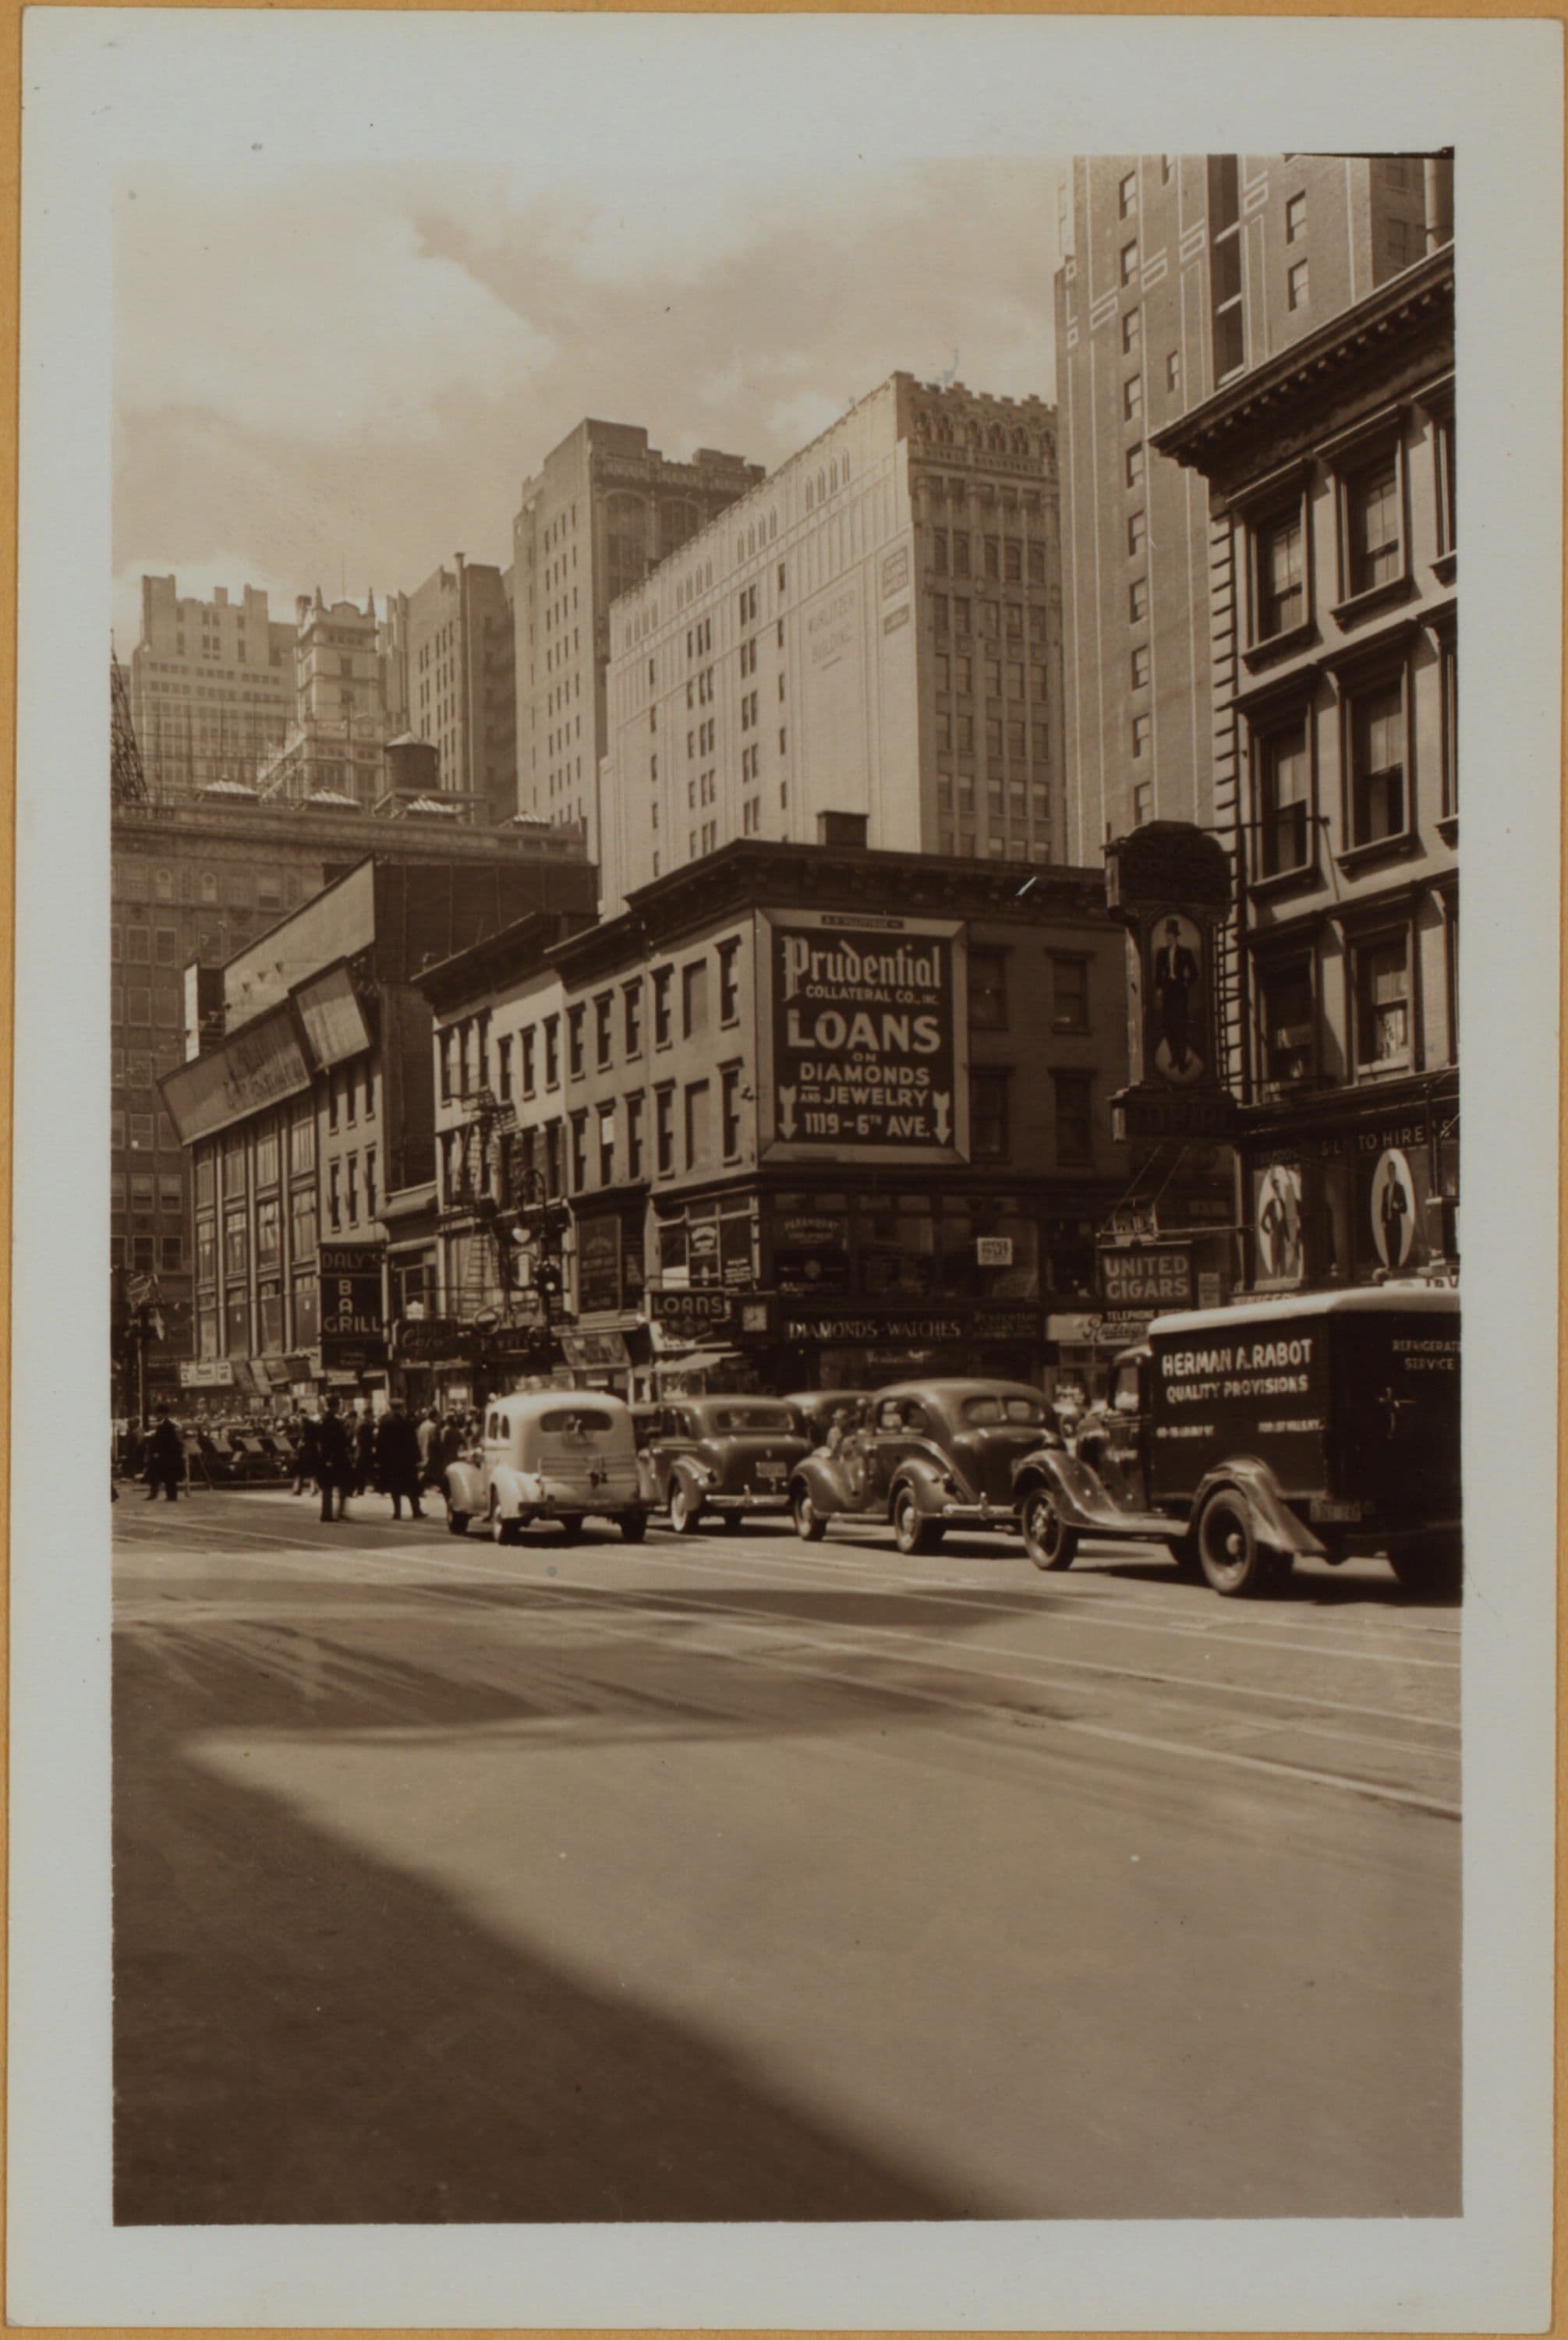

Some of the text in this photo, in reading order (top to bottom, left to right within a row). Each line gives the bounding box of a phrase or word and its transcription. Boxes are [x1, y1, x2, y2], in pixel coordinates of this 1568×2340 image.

[780, 936, 941, 1001] Prudential
[805, 985, 891, 1003] COLLATERAL
[788, 1008, 941, 1053] LOANS
[851, 1052, 877, 1063] ON
[800, 1062, 930, 1085] DIAMONDS
[800, 1085, 928, 1107] AND JEWELRY
[887, 1115, 931, 1137] AVE.
[1358, 1134, 1377, 1151] TO
[1382, 1125, 1425, 1146] HIRE
[322, 1251, 382, 1269] DALY'S
[1103, 1255, 1189, 1277] UNITED
[1106, 1277, 1189, 1300] CIGARS
[653, 1295, 724, 1315] LOANS
[324, 1315, 381, 1333] GRILL
[788, 1321, 879, 1340] DIAMONDS
[885, 1322, 961, 1339] WATCHES
[1162, 1347, 1232, 1378] HERMAN
[1251, 1339, 1313, 1369] RABOT
[1404, 1358, 1456, 1372] SERVICE
[1166, 1375, 1309, 1404] QUALITY PROVISIONS
